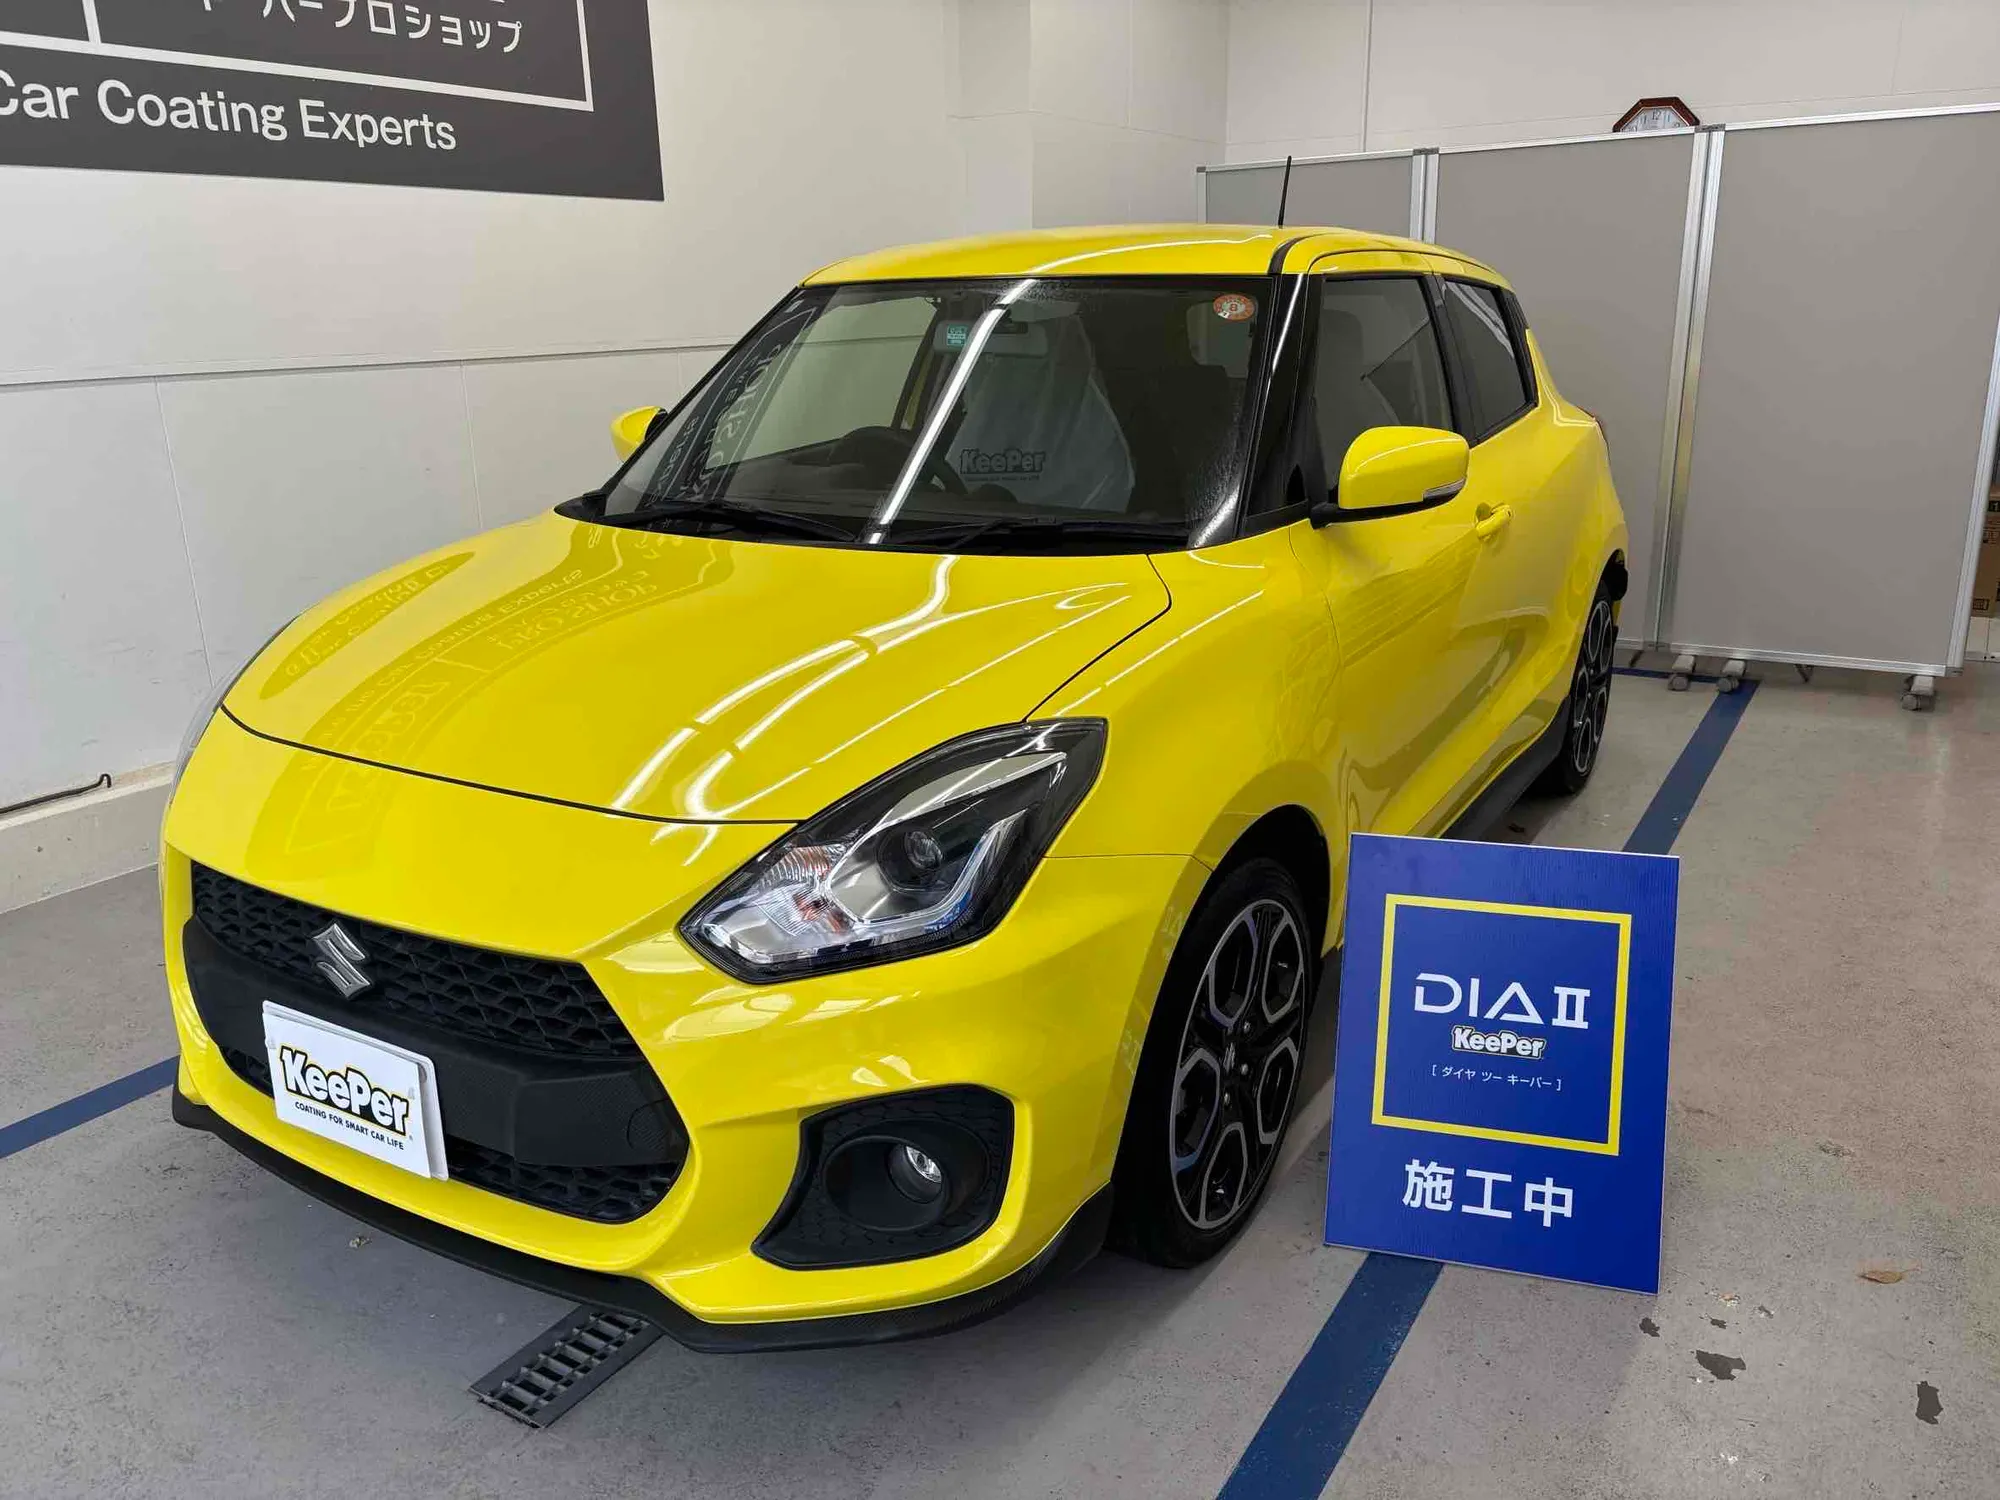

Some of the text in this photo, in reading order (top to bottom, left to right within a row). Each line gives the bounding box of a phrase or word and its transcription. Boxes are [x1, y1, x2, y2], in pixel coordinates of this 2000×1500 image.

[0, 69, 457, 150] Car Coating Experts
[960, 448, 1047, 474] KeePer
[1451, 1025, 1547, 1060] KeePer
[280, 1045, 410, 1136] KeePer
[294, 1101, 405, 1151] COATING FOR SMART CAR LIFE
[1402, 1158, 1574, 1228] 施工中
